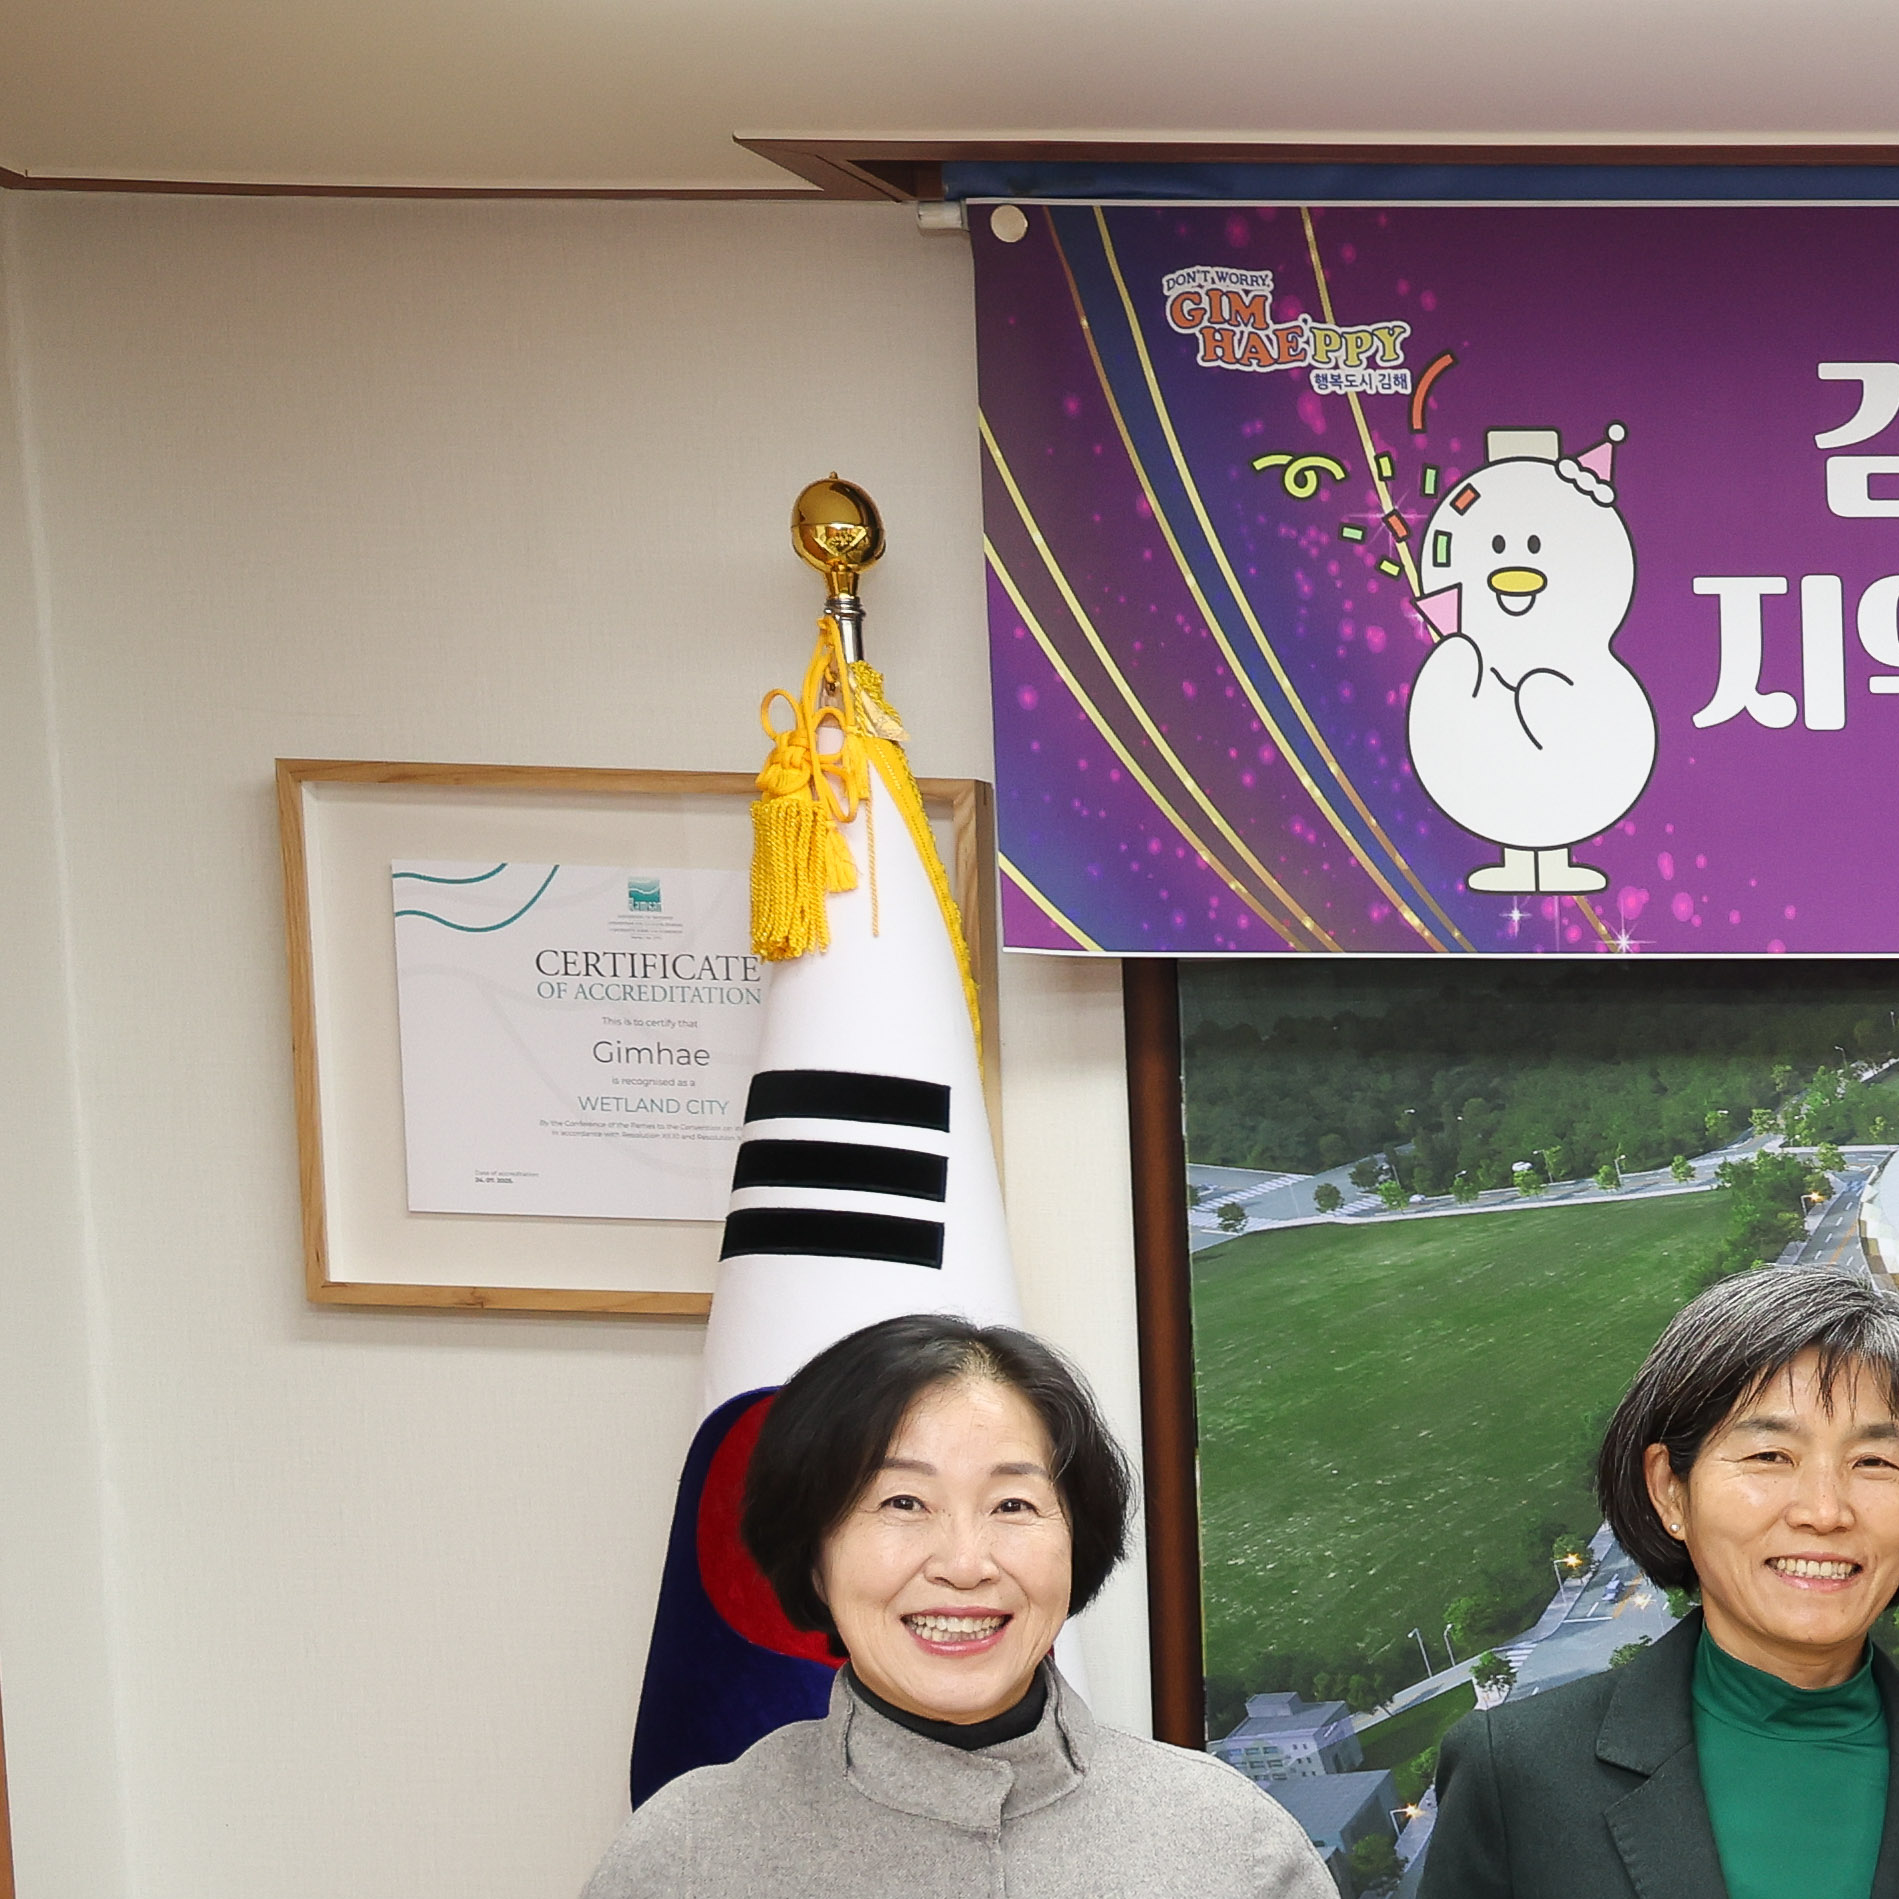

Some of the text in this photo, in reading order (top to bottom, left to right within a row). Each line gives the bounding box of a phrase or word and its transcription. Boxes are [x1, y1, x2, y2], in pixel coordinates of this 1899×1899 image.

[1170, 289, 1269, 330] GIM
[1313, 373, 1408, 391] 행복도시 김해
[535, 949, 762, 983] CERTIFICATE
[537, 981, 762, 1006] OF ACCREDITATION
[602, 1016, 622, 1026] This
[633, 1018, 644, 1027] to
[646, 1018, 676, 1029] certify
[678, 1018, 698, 1028] that
[592, 1040, 711, 1067] Gimhae
[621, 1077, 675, 1087] recognised
[577, 1096, 730, 1115] WETLAND CITY
